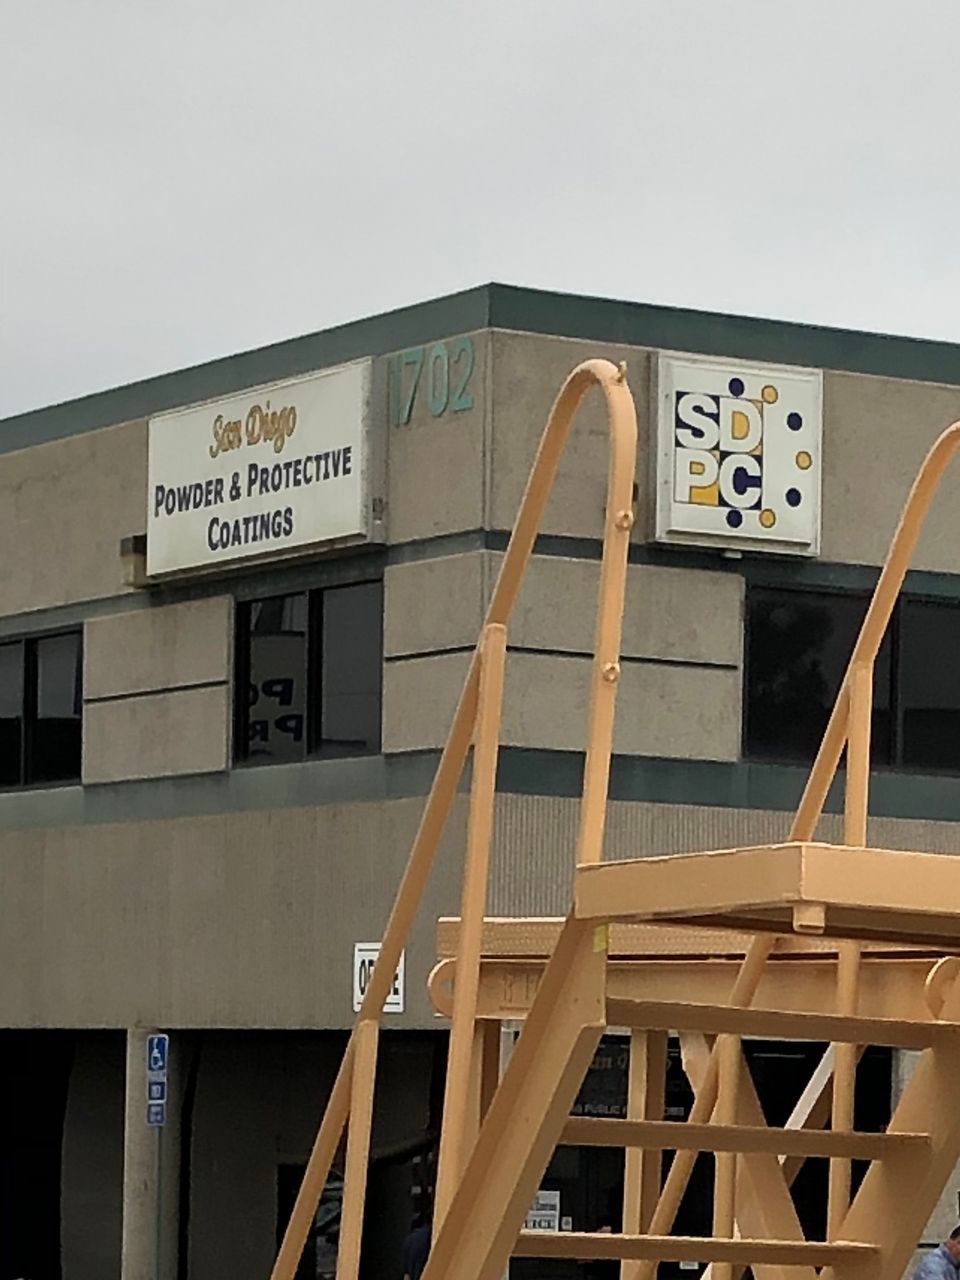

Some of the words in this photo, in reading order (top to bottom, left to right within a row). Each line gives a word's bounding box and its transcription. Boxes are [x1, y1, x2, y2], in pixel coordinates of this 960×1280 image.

[209, 414, 242, 459] San
[245, 399, 297, 454] Diego
[153, 477, 225, 518] POWDER
[229, 471, 242, 501] &
[246, 445, 353, 498] PROTECTIVE
[207, 506, 294, 552] COATINGS
